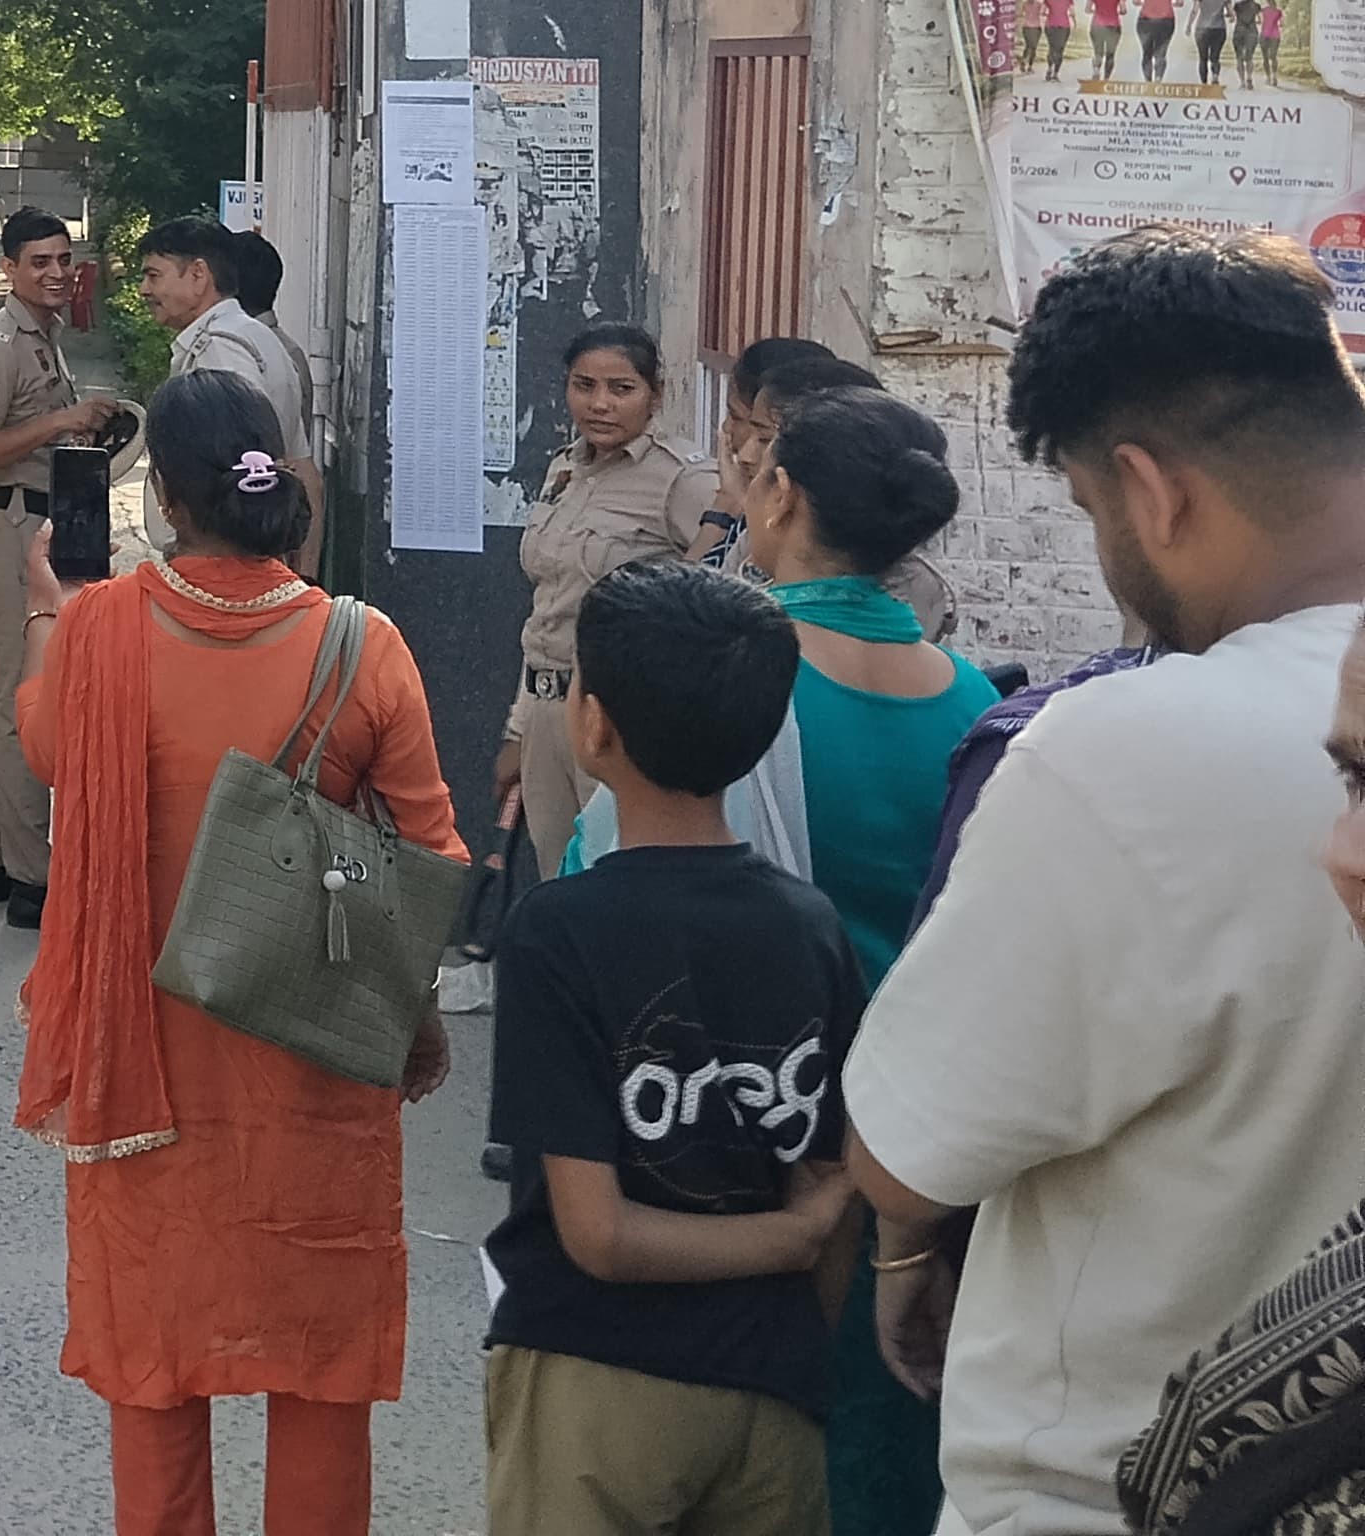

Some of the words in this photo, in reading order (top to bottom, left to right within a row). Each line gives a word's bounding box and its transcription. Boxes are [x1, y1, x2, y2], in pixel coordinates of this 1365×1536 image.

[471, 60, 568, 83] HINDUSTAN
[569, 64, 594, 85] ITI
[1155, 85, 1202, 97] GUEST
[1053, 97, 1169, 119] GAURAV
[1183, 102, 1303, 125] GAUTAM
[1152, 172, 1172, 182] AM
[1108, 199, 1182, 212] ORGANISED
[1037, 209, 1062, 225] Dr
